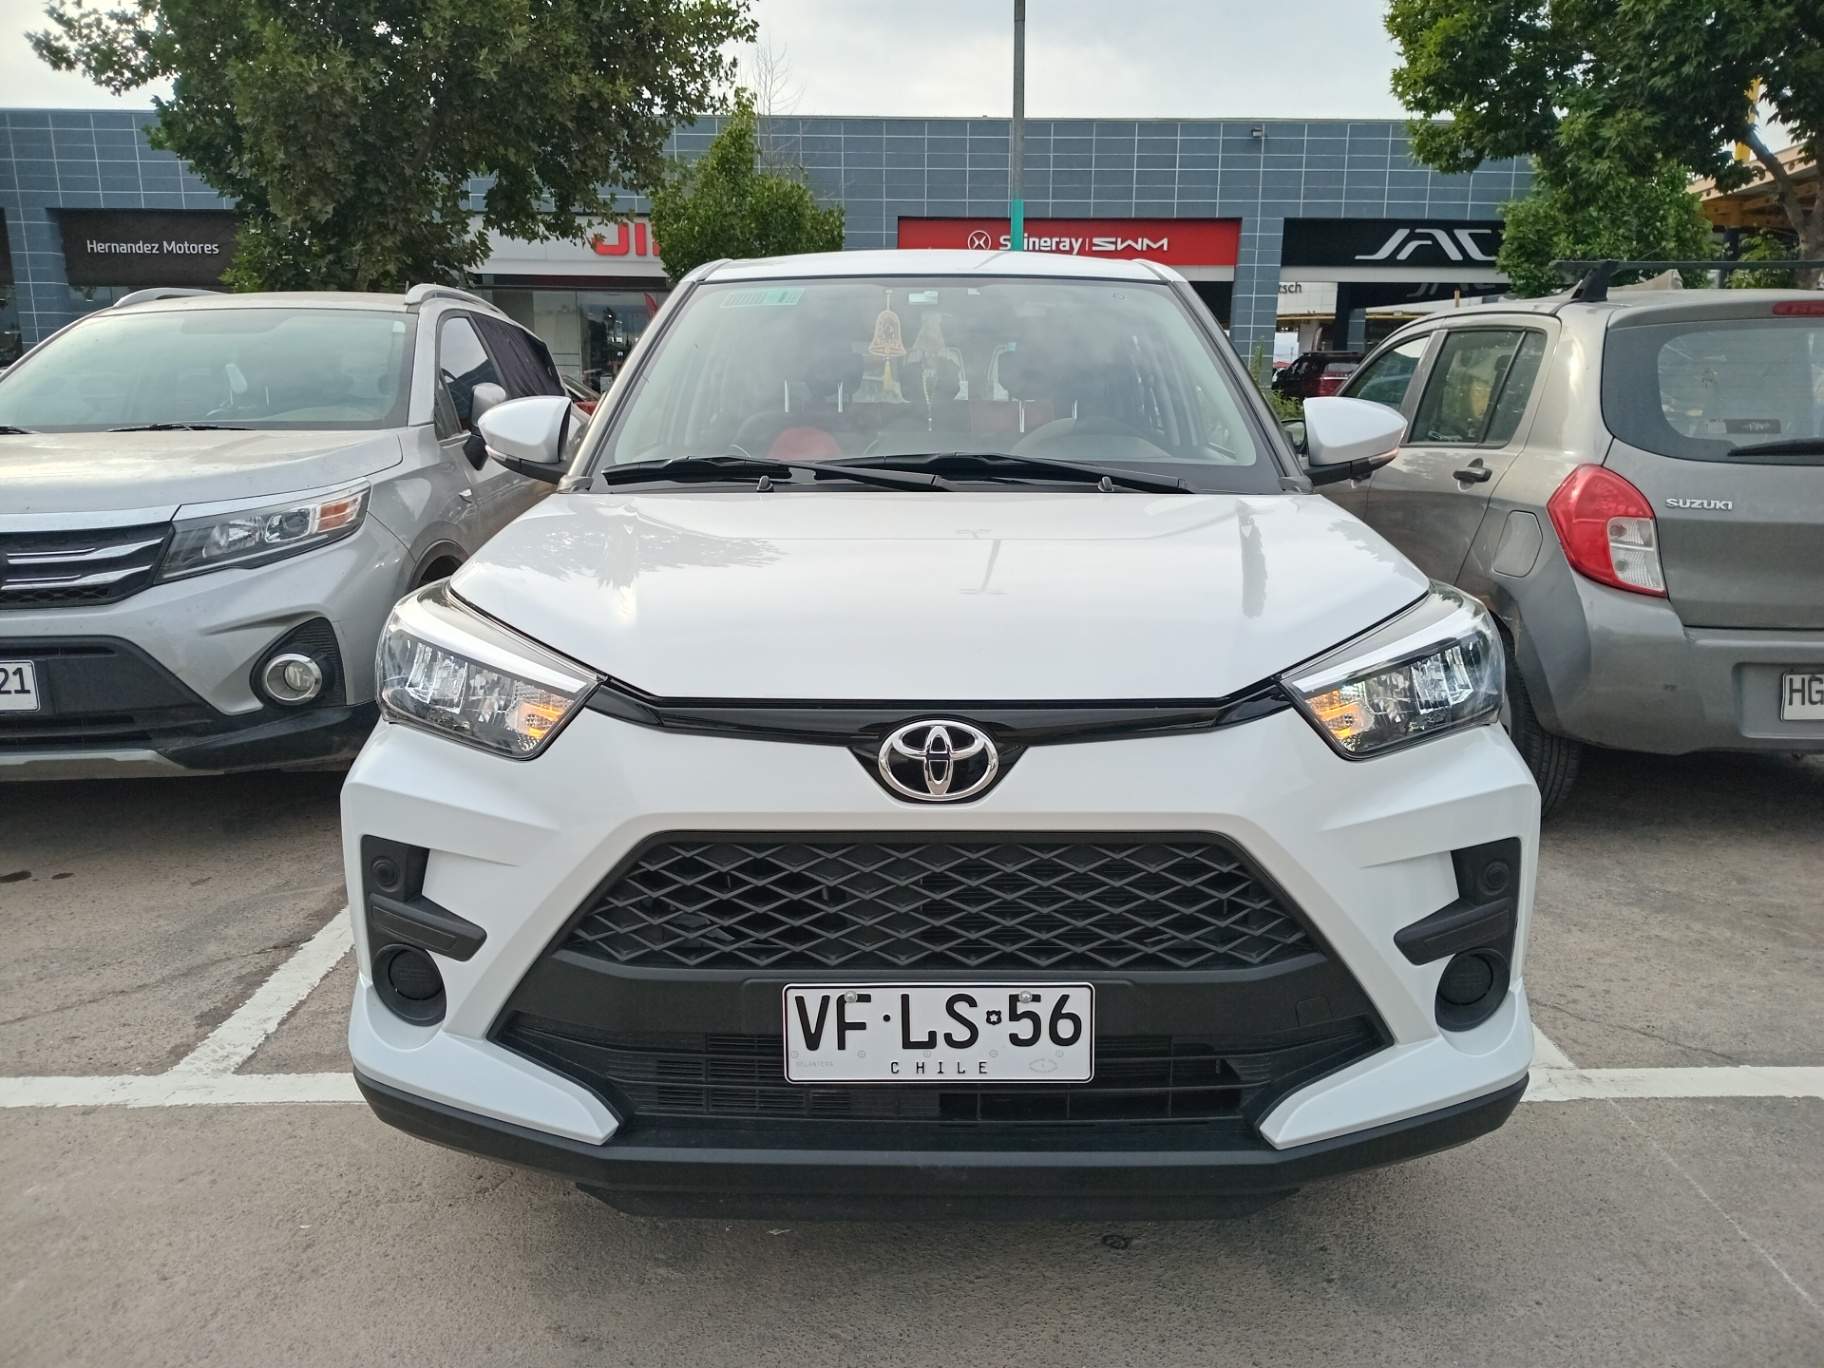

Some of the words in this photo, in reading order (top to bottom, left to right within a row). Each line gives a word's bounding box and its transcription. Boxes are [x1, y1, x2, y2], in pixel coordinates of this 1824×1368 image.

[86, 239, 160, 254] Hernandez
[162, 240, 220, 254] Motores
[592, 222, 661, 257] JI
[1000, 232, 1083, 255] Sineray
[1092, 237, 1169, 252] SWM
[1354, 228, 1497, 261] JAC
[1665, 498, 1734, 511] SUZUKI
[890, 1061, 988, 1074] CHILE
